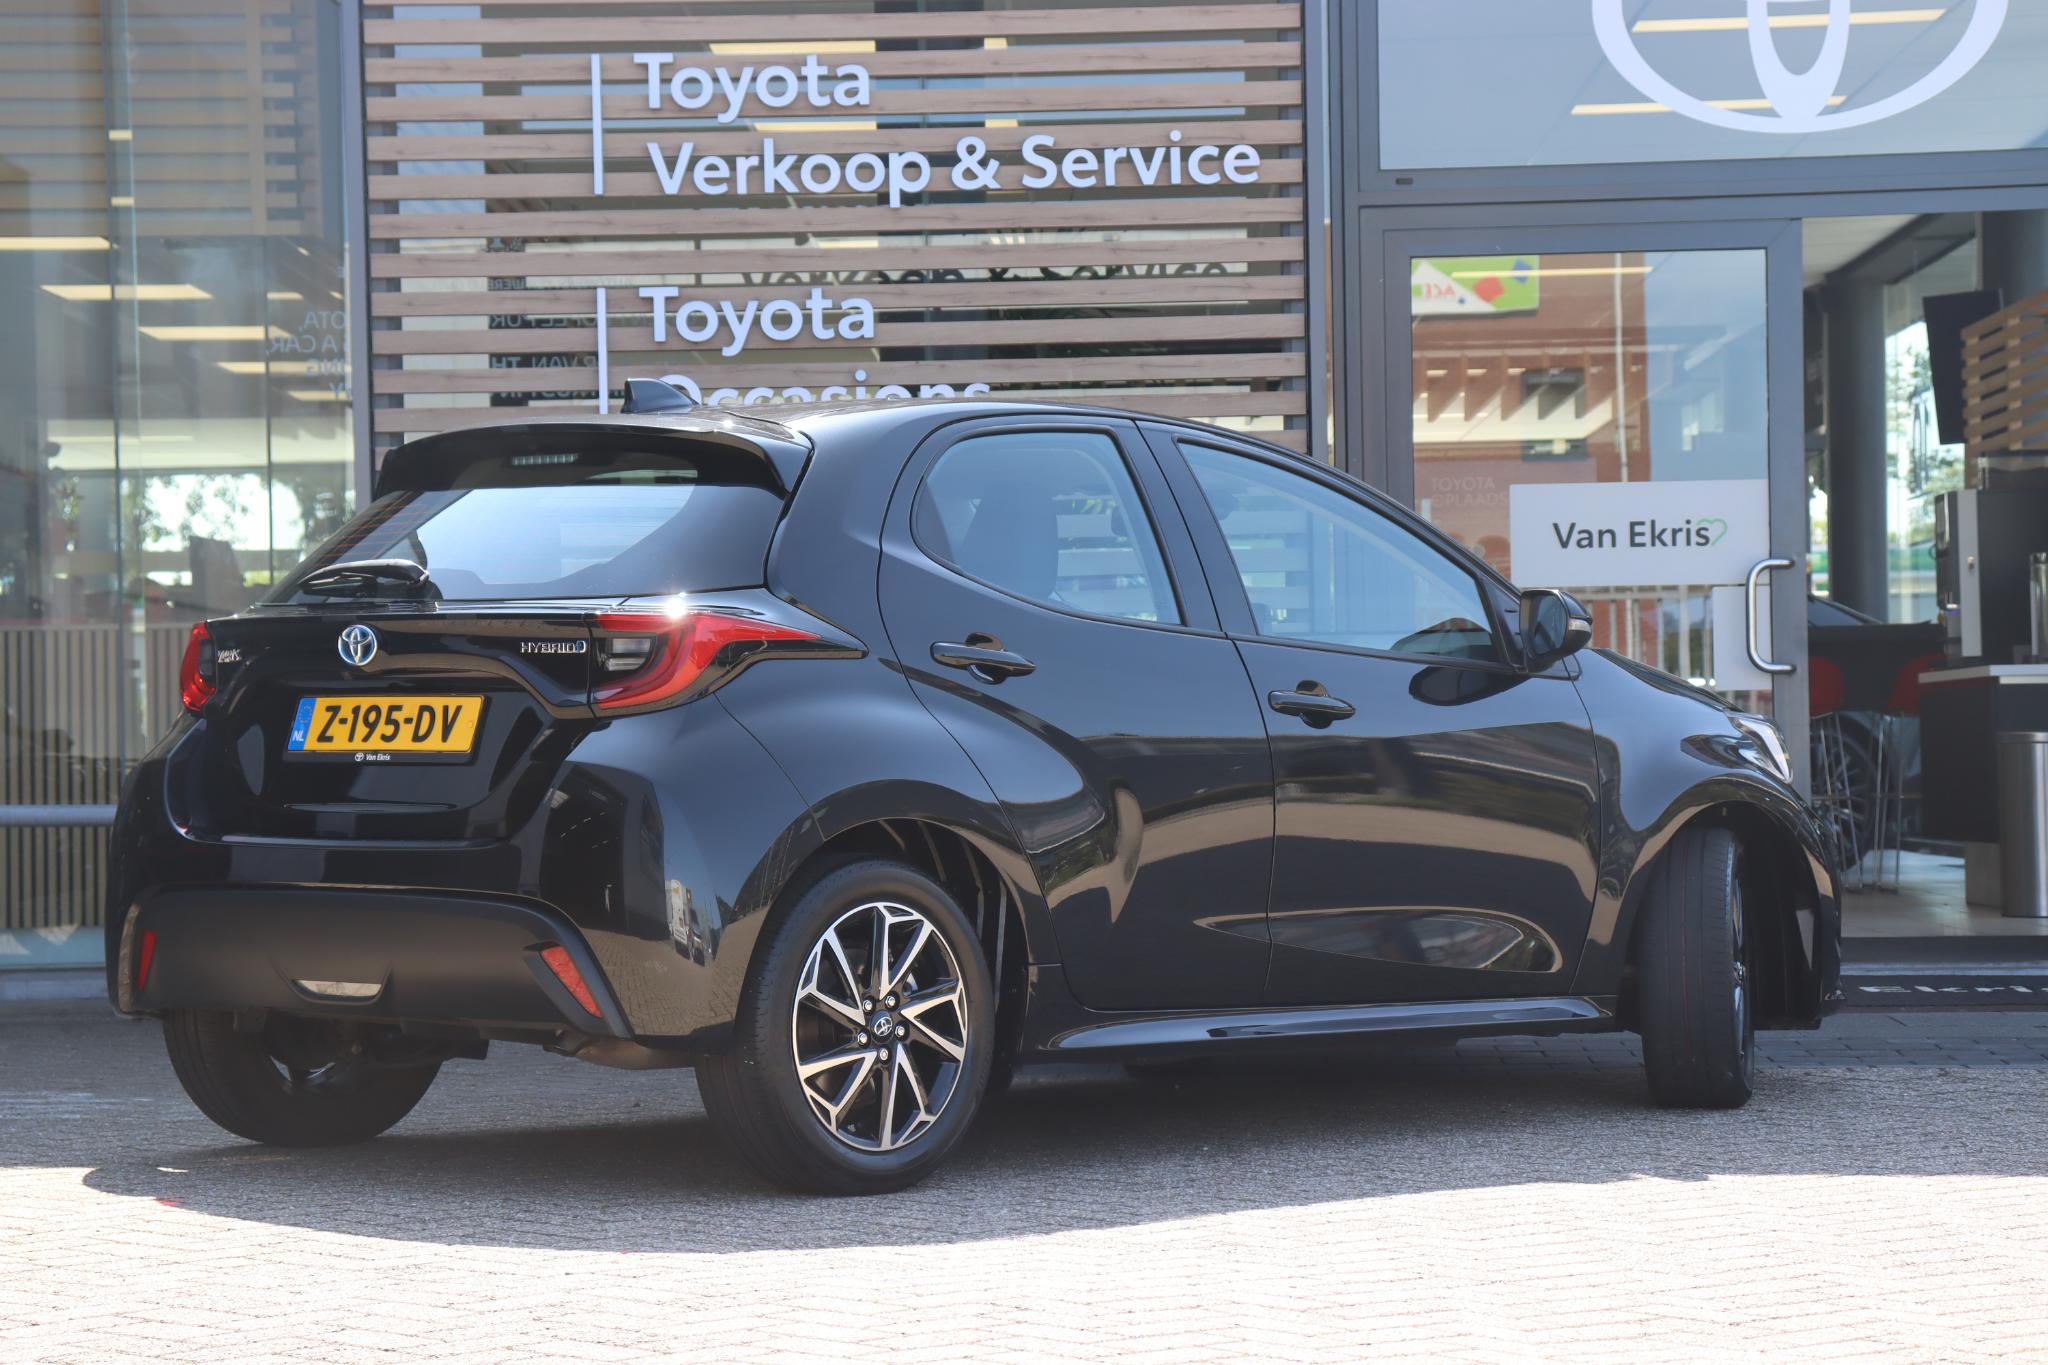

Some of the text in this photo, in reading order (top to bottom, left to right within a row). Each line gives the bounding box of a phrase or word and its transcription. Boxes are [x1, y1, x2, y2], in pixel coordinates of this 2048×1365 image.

[633, 52, 871, 123] Toyota
[646, 130, 1261, 208] Verkoop & Service
[638, 286, 876, 358] Toyota
[1552, 519, 1711, 549] Van Ekris
[292, 729, 304, 742] NL
[316, 704, 463, 744] Z-195-DV
[365, 753, 377, 761] Van
[1858, 985, 2048, 993] Ekri
